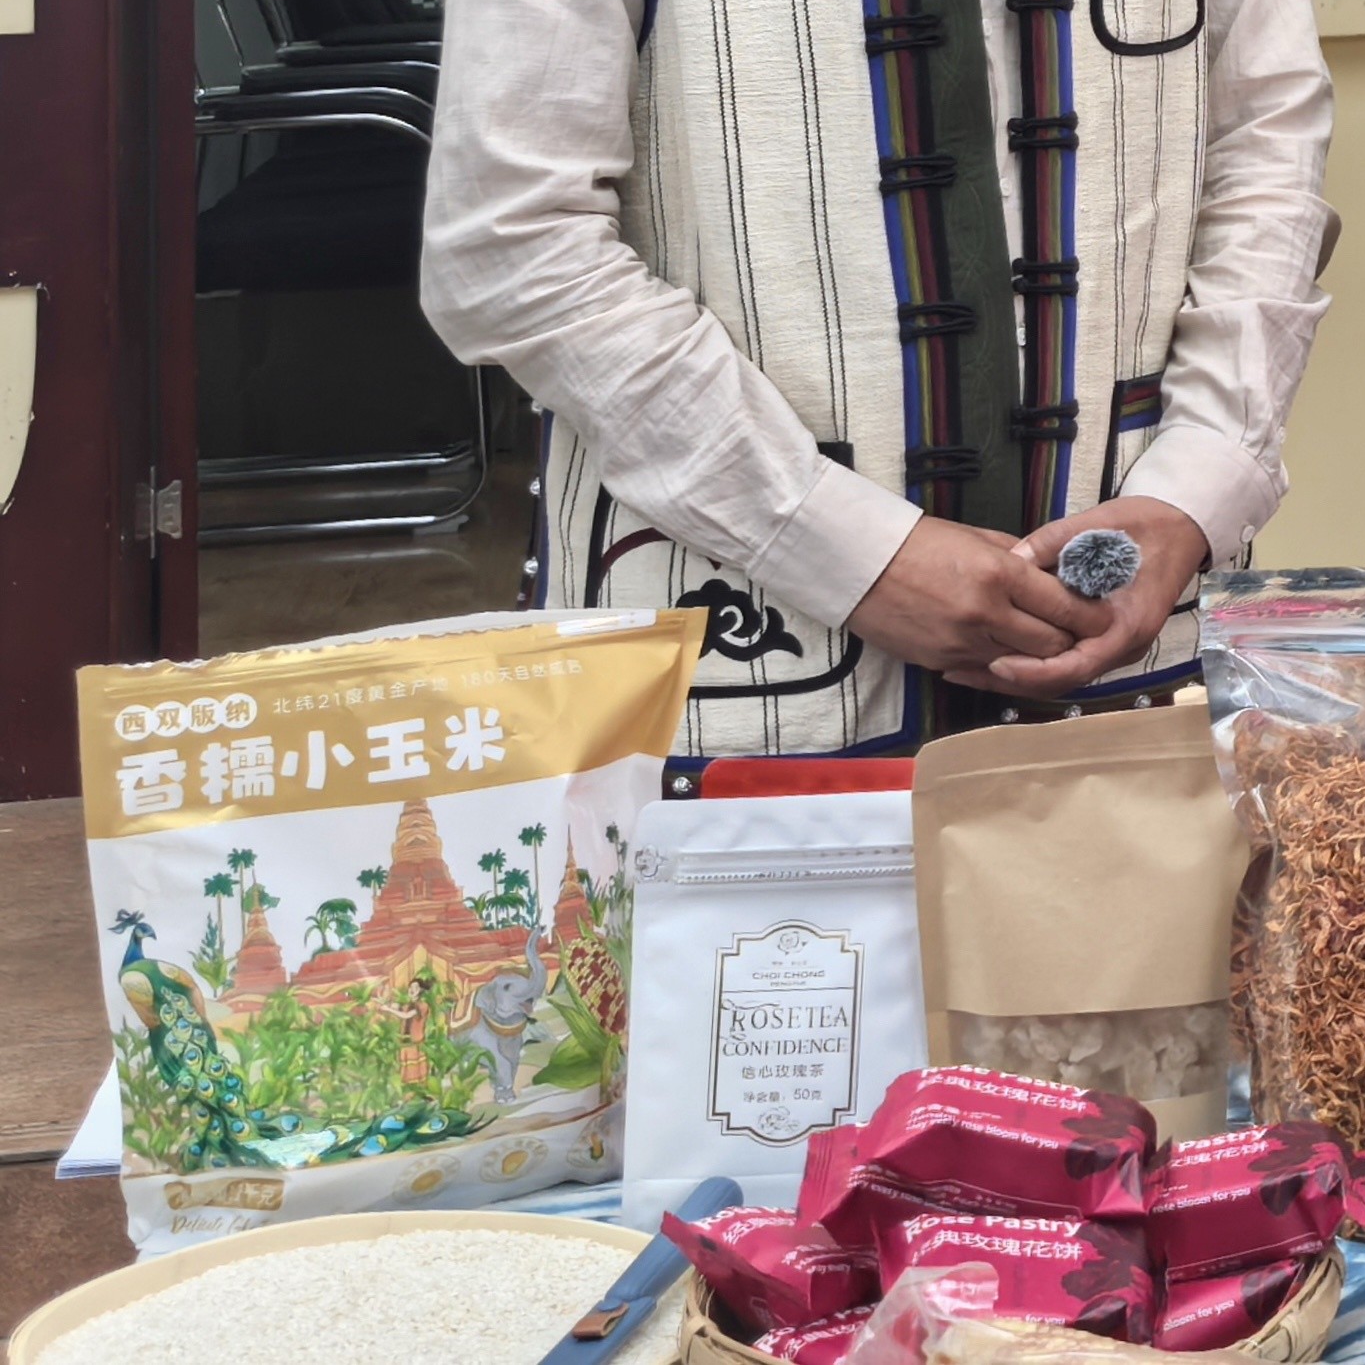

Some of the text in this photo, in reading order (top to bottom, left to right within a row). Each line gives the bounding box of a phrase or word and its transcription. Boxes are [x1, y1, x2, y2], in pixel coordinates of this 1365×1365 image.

[121, 699, 251, 735] 西双版纳
[115, 706, 507, 817] 香糯小玉米
[722, 1038, 850, 1056] CONFIDENCE
[742, 1063, 824, 1079] 信心玫瑰茶
[1038, 1138, 1059, 1150] you
[1178, 1128, 1268, 1153] Pastry
[1229, 1187, 1251, 1202] you
[985, 1215, 1083, 1238] Pastry
[1213, 1299, 1235, 1316] you
